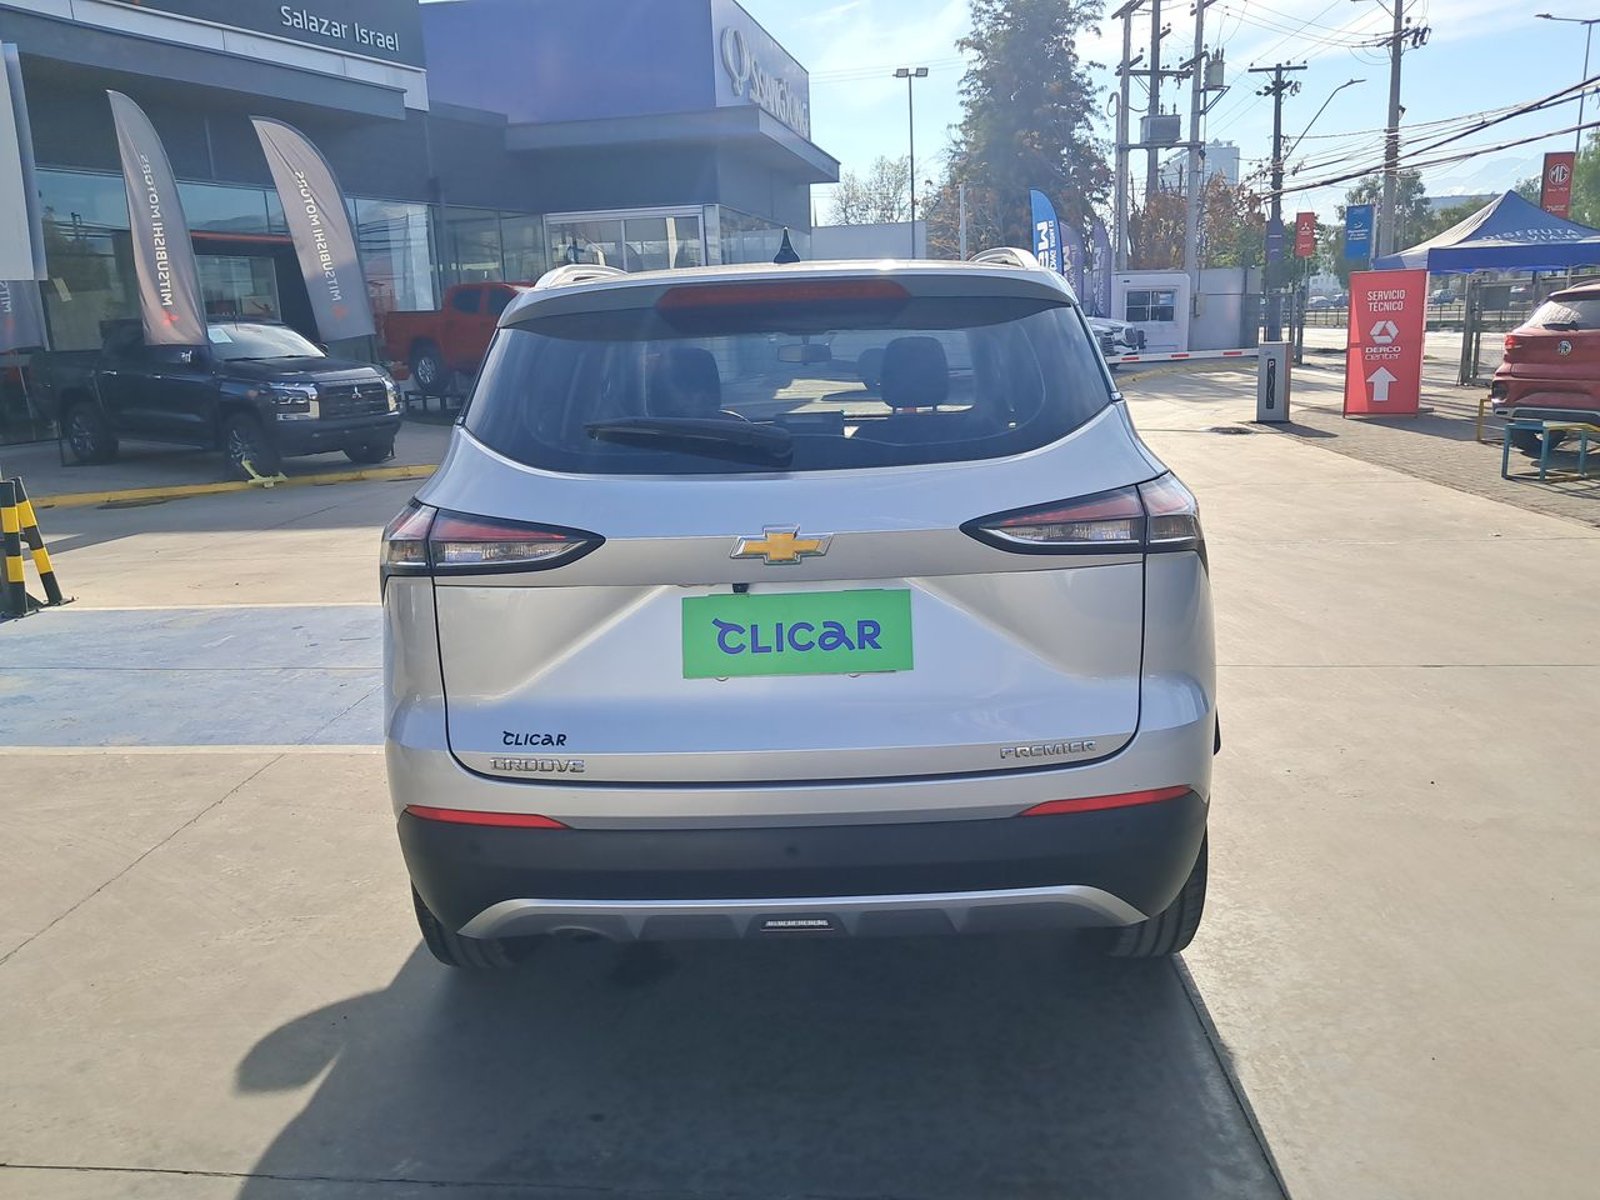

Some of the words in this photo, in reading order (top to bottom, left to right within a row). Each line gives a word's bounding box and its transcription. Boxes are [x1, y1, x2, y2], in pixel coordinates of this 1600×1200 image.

[280, 5, 348, 39] Salazar
[354, 22, 400, 52] Israel
[1367, 289, 1406, 301] SERVICIO
[1000, 740, 1096, 759] PREMIER
[490, 757, 584, 773] GROOVE
